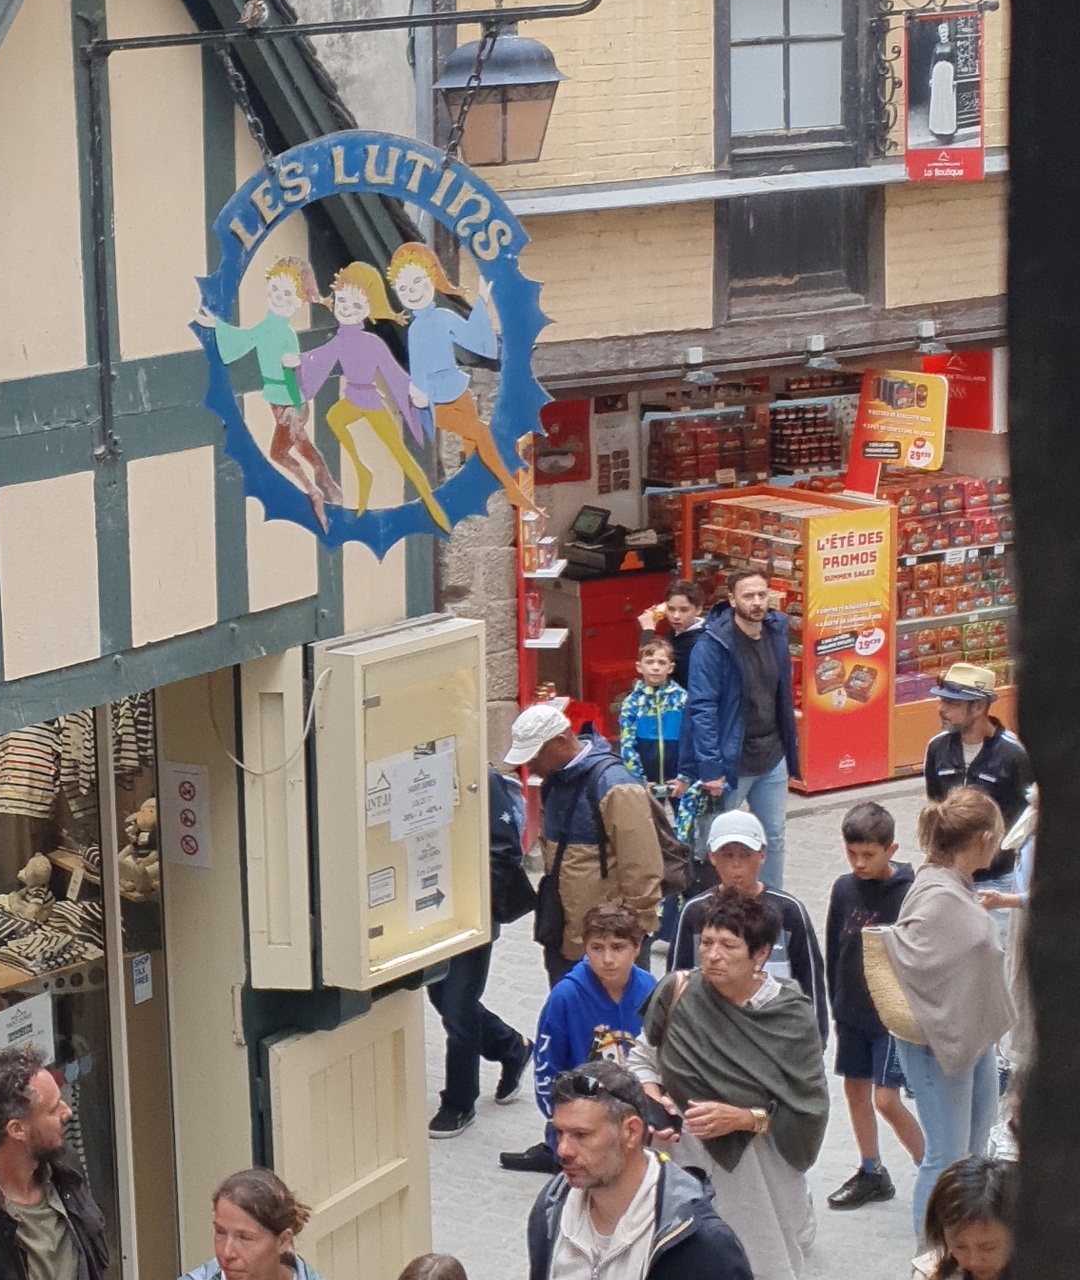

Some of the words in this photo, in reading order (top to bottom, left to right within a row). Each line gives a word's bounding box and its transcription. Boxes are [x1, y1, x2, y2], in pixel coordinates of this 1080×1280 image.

[934, 168, 964, 177] Boutique
[229, 162, 312, 252] LES
[332, 144, 514, 261] LUTINS
[817, 531, 855, 551] L'ÉTÉ
[858, 531, 883, 545] DES
[822, 551, 877, 570] PROMOS
[824, 572, 852, 582] SUMMER
[853, 569, 875, 578] SALES
[134, 968, 145, 977] TAX
[135, 974, 149, 986] FREE
